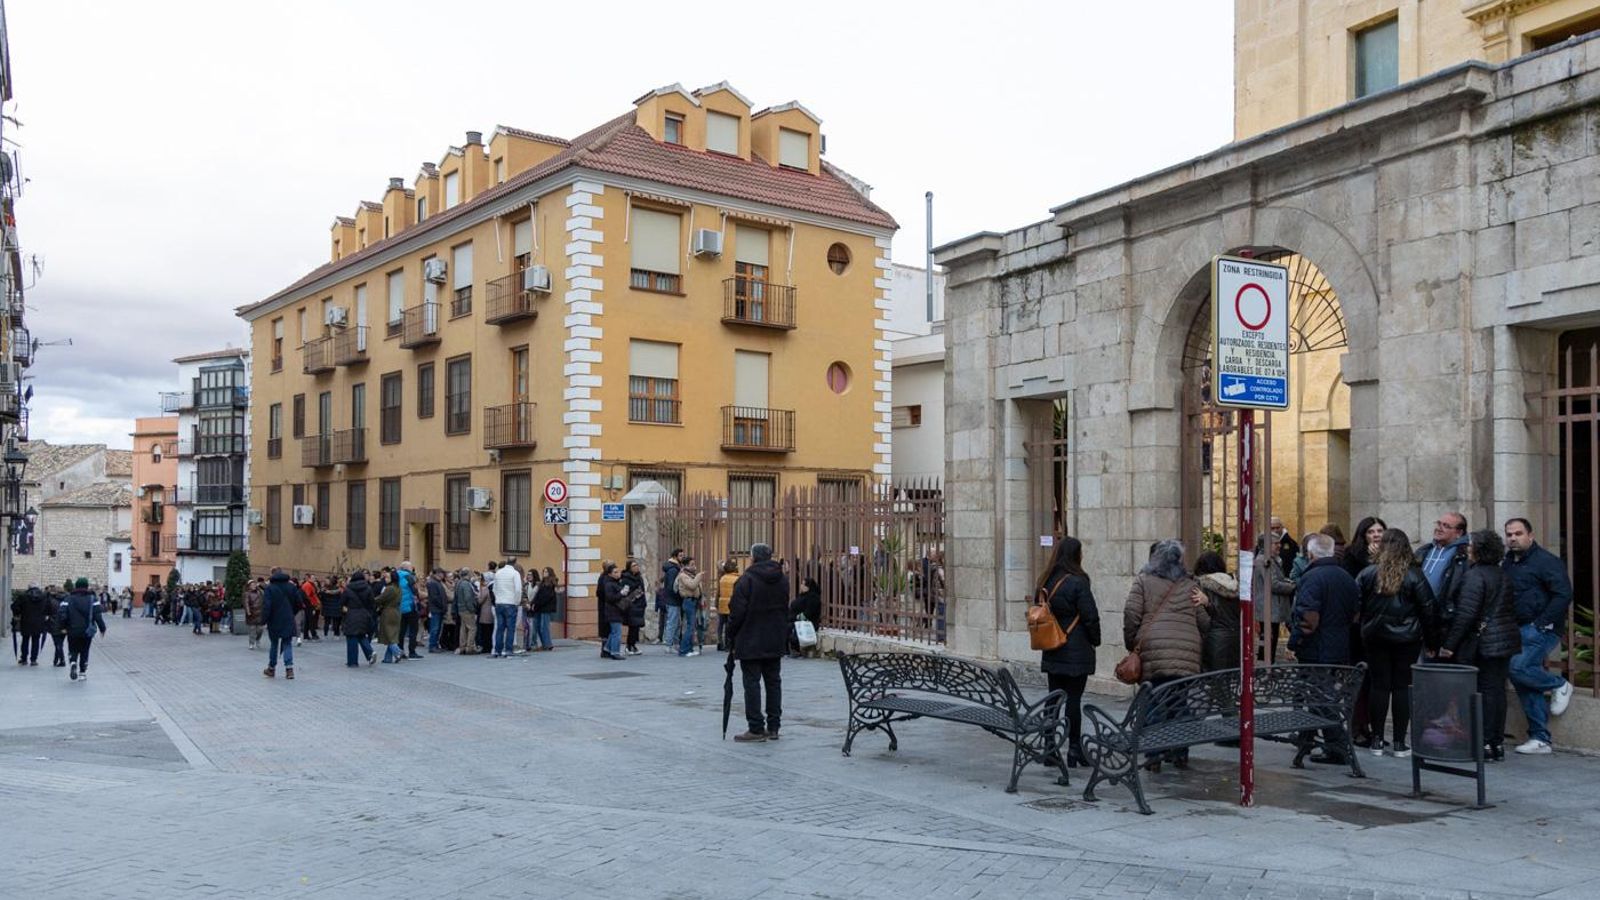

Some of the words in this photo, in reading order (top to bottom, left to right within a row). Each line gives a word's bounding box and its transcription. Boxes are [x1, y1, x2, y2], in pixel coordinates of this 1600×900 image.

[1223, 264, 1240, 273] ZONA
[1244, 268, 1282, 280] RESTRINGIDA
[1242, 331, 1264, 339] EXCEPTO
[1258, 341, 1286, 350] RESIDENTES
[1256, 358, 1281, 367] DESCARGA
[1250, 386, 1283, 394] CONTROLADO
[551, 487, 561, 495] 20
